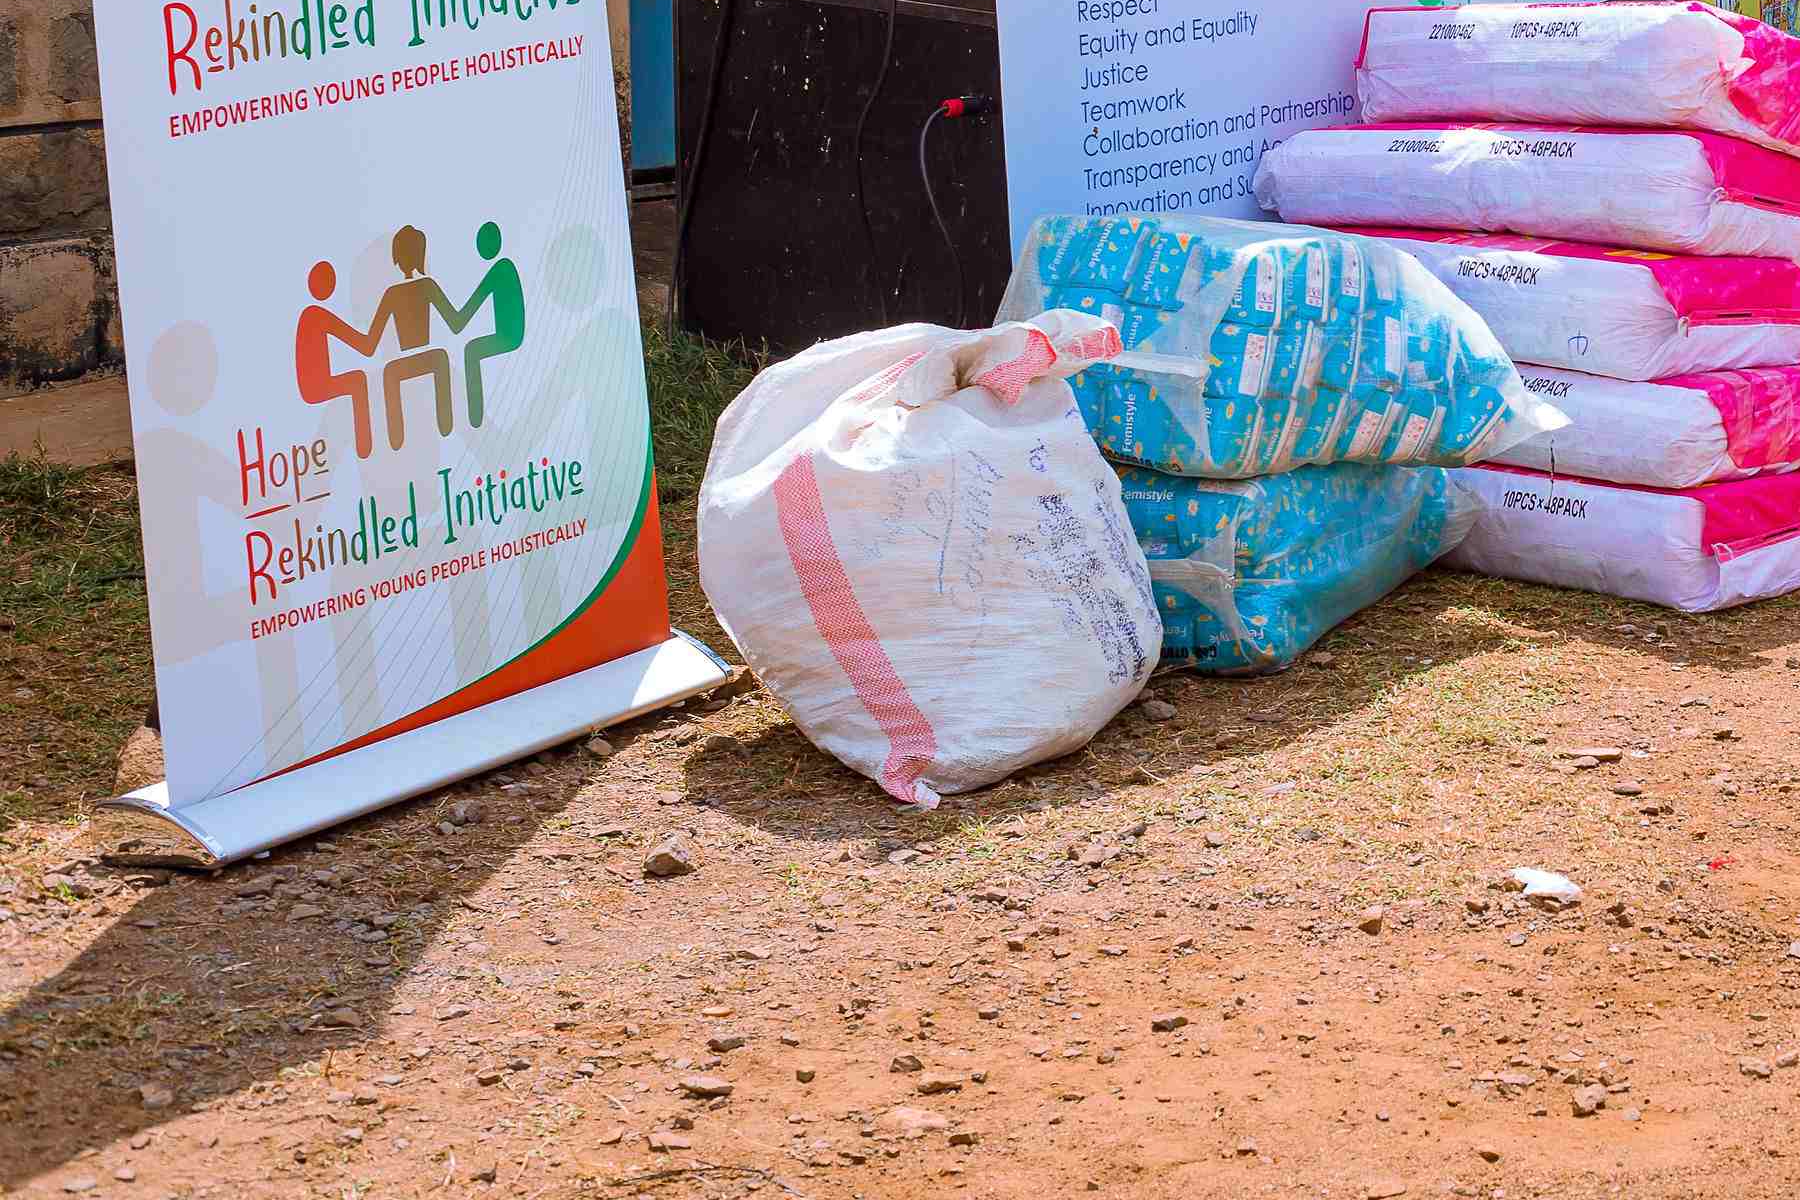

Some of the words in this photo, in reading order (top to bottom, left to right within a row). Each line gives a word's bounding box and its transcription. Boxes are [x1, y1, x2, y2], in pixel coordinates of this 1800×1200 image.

[1079, 26, 1138, 58] Equity
[1144, 21, 1186, 47] and
[1192, 10, 1258, 43] Equality
[169, 88, 308, 138] EMPOWERING
[313, 74, 386, 107] YOUNG
[391, 59, 460, 92] PEOPLE
[464, 34, 585, 78] HOLISTICALLY
[1080, 61, 1149, 91] Justice
[1081, 88, 1186, 124] Teamwork
[1123, 392, 1138, 453] Femistyle
[237, 427, 330, 505] Hope
[245, 481, 419, 606] Rekindled
[438, 456, 584, 545] Initiative
[250, 587, 366, 639] EMPOWERING
[370, 572, 427, 602] YOUNG
[431, 552, 486, 584] PEOPLE
[491, 518, 588, 564] HOLISTICALLY
